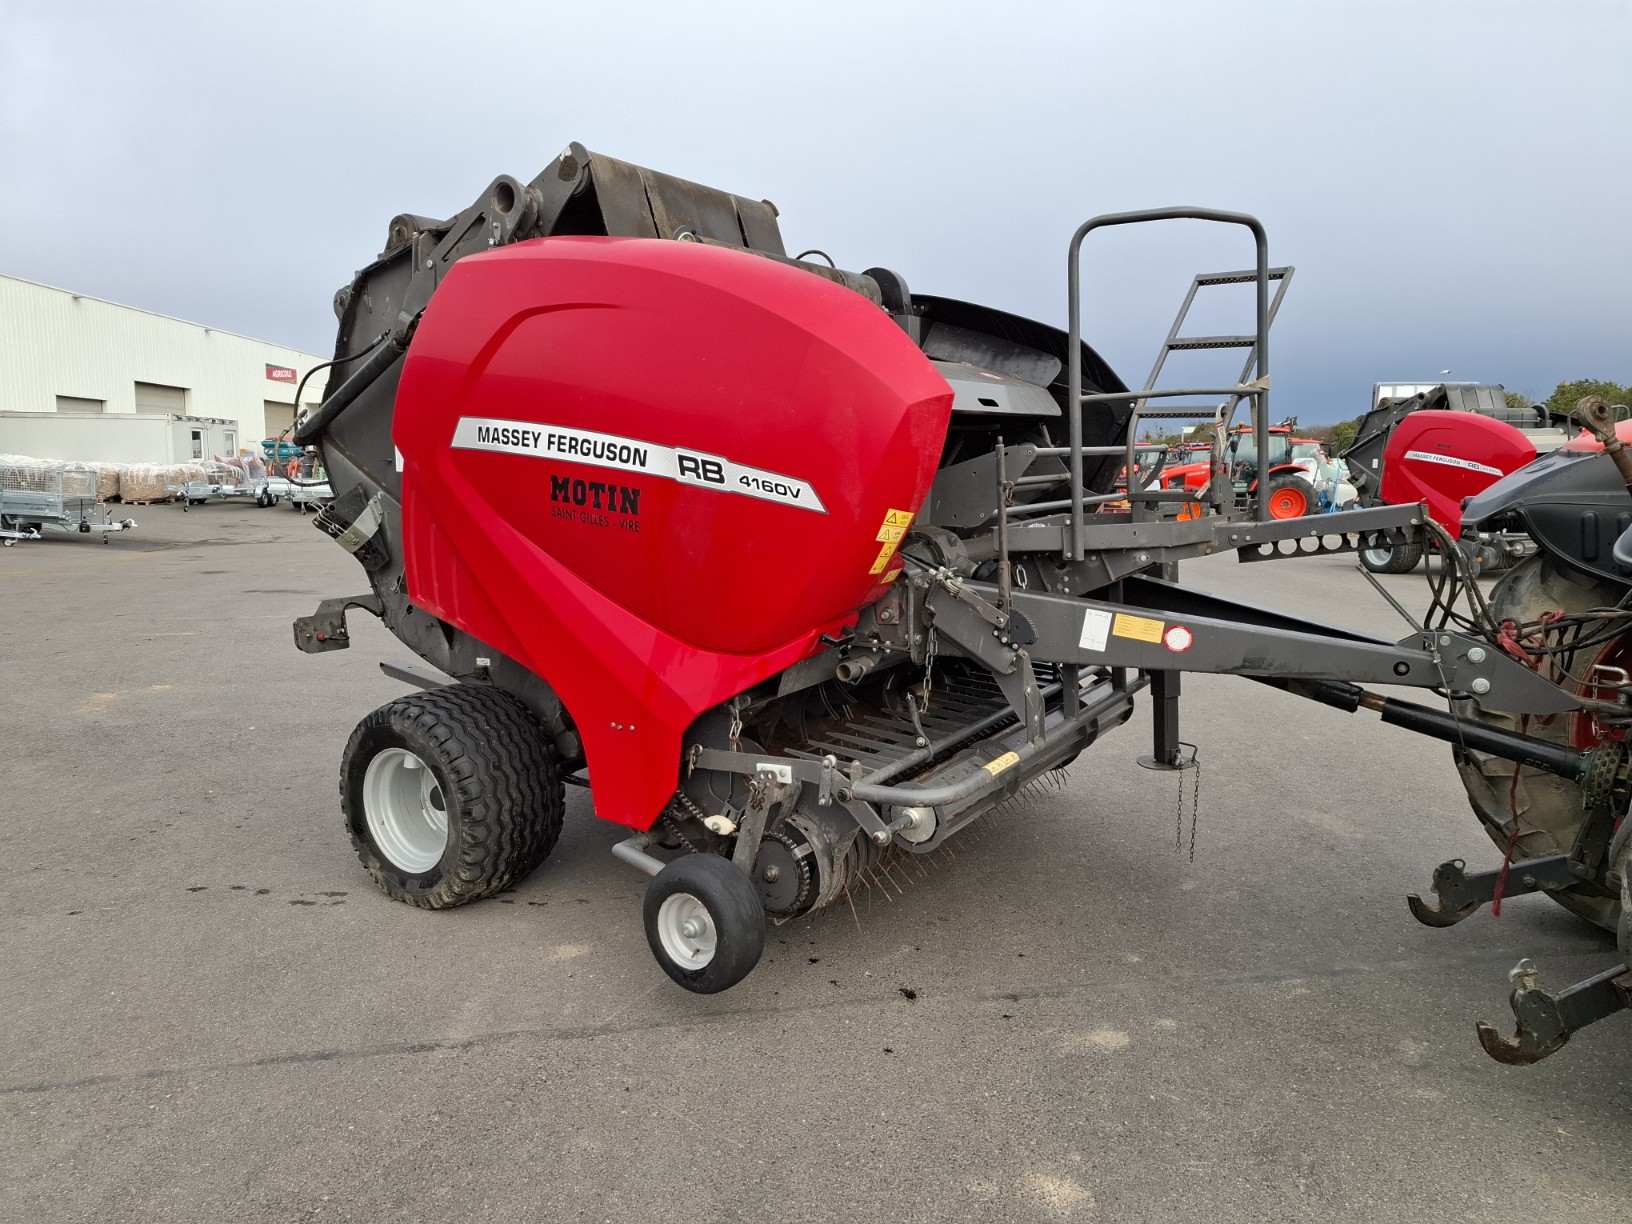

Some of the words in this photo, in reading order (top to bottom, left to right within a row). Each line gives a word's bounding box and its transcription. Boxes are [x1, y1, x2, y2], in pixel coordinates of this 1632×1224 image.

[477, 426, 542, 448] MASSEY
[547, 433, 648, 467] FERGUSON
[677, 454, 725, 484] RB
[739, 475, 801, 499] 4160V
[1433, 456, 1460, 465] FERGUSON
[550, 475, 641, 516] MOTIN
[551, 506, 578, 520] SAINT
[579, 511, 610, 528] GILLES
[619, 519, 640, 533] VIRE
